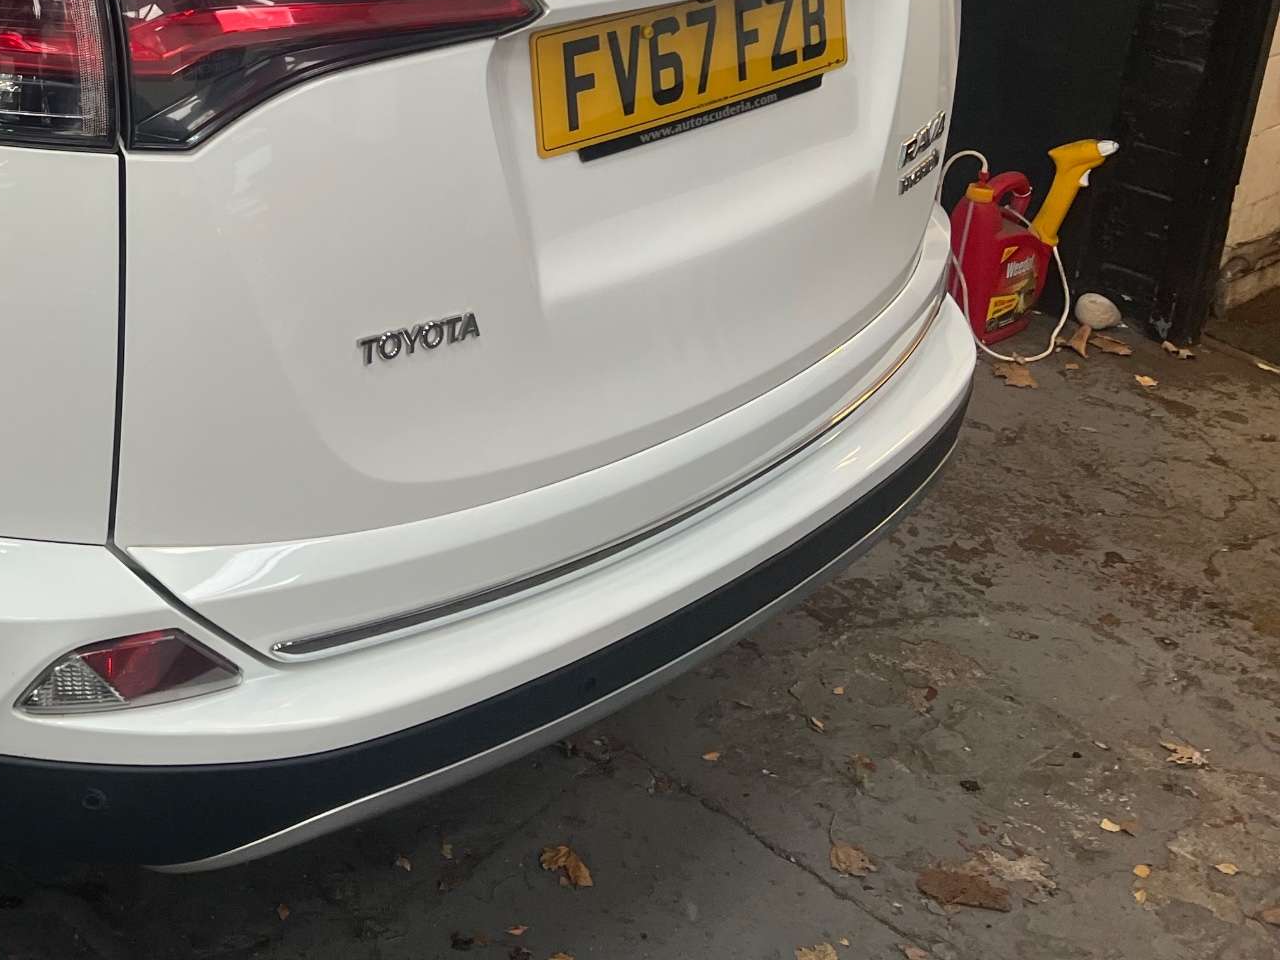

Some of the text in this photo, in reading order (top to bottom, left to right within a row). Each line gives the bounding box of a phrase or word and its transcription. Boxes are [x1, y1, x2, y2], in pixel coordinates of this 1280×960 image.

[562, 5, 717, 132] FV67
[639, 92, 779, 144] www.autoscuderia.com
[357, 312, 481, 365] TOYOTA
